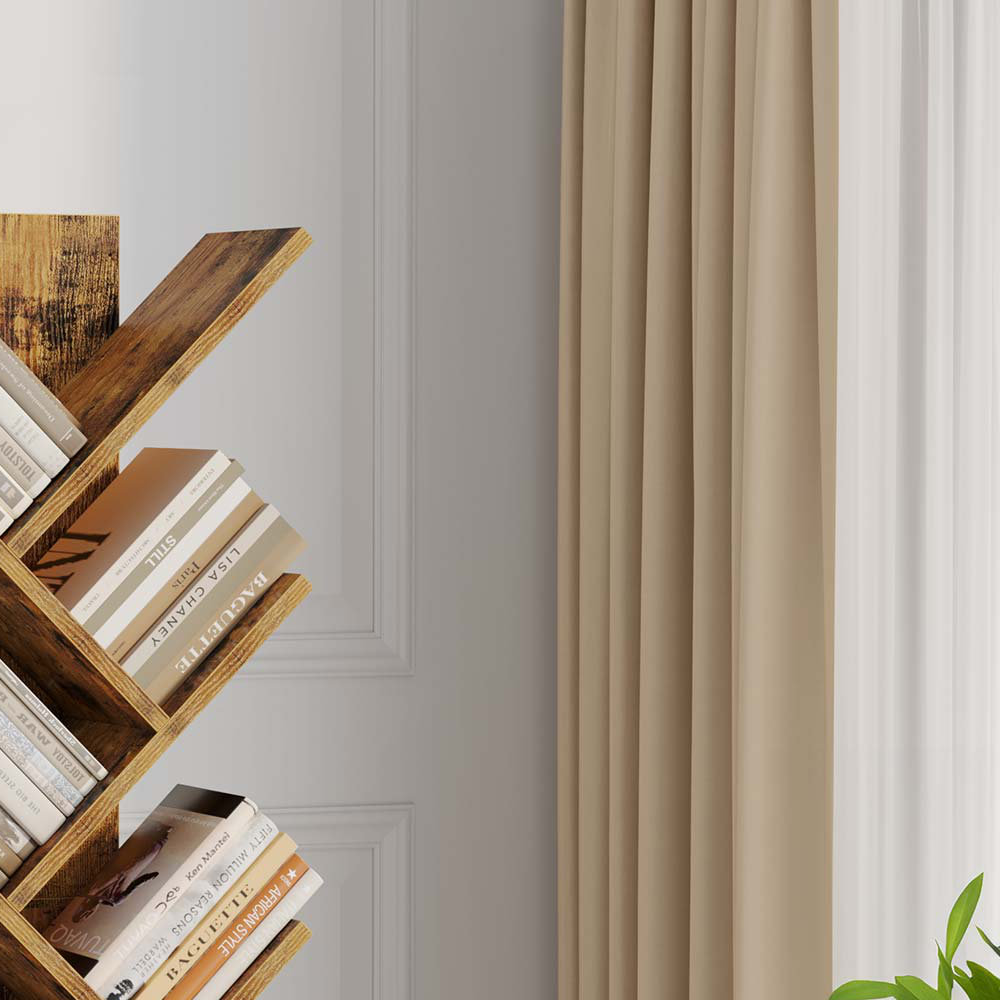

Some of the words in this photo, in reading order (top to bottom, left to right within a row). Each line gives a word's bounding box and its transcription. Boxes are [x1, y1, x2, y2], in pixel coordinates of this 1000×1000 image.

[144, 533, 178, 569] STILL
[207, 546, 241, 583] LISA
[170, 560, 201, 591] Paris
[148, 584, 207, 647] CHANEY
[173, 570, 270, 674] BAGUETTE
[184, 860, 204, 882] Ken
[199, 830, 231, 865] Mantel
[247, 822, 273, 851] FIFTY
[211, 849, 250, 891] MILLION
[170, 889, 214, 937] REASONS
[242, 883, 284, 928] AFRICAN
[164, 882, 254, 982] BAGUETTE
[217, 922, 249, 957] STYLE
[132, 935, 168, 975] WARDELL
